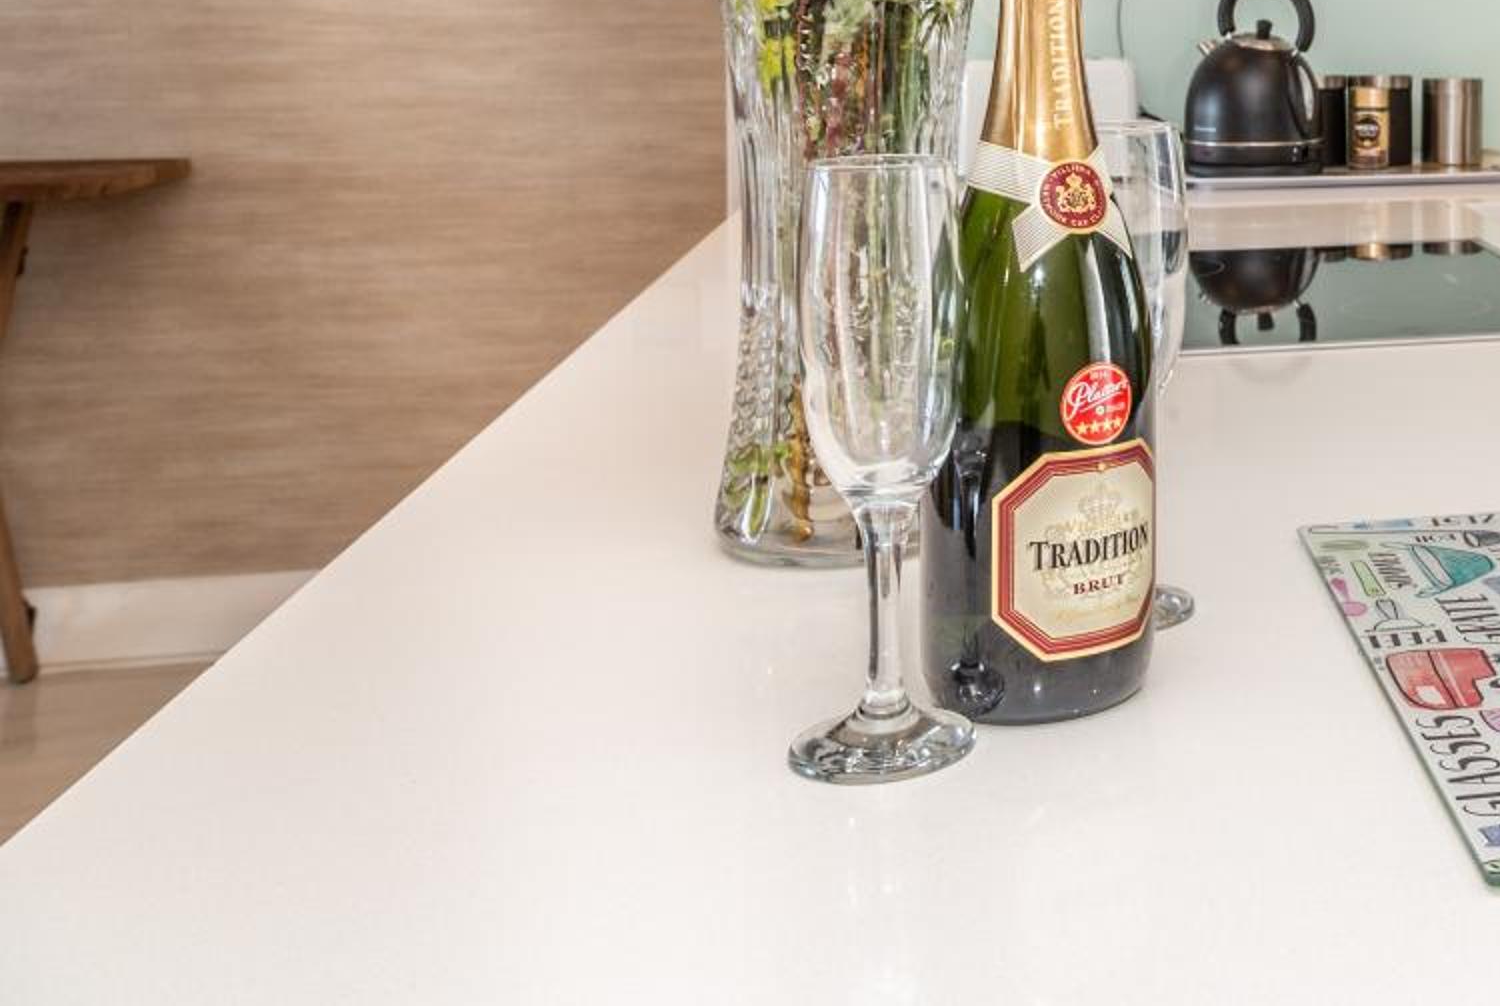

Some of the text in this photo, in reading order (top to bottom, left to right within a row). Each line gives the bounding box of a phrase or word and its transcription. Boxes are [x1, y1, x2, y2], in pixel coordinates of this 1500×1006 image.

[1026, 520, 1149, 571] TRADITION
[1073, 574, 1125, 595] BRUT
[1366, 630, 1446, 649] PEEL
